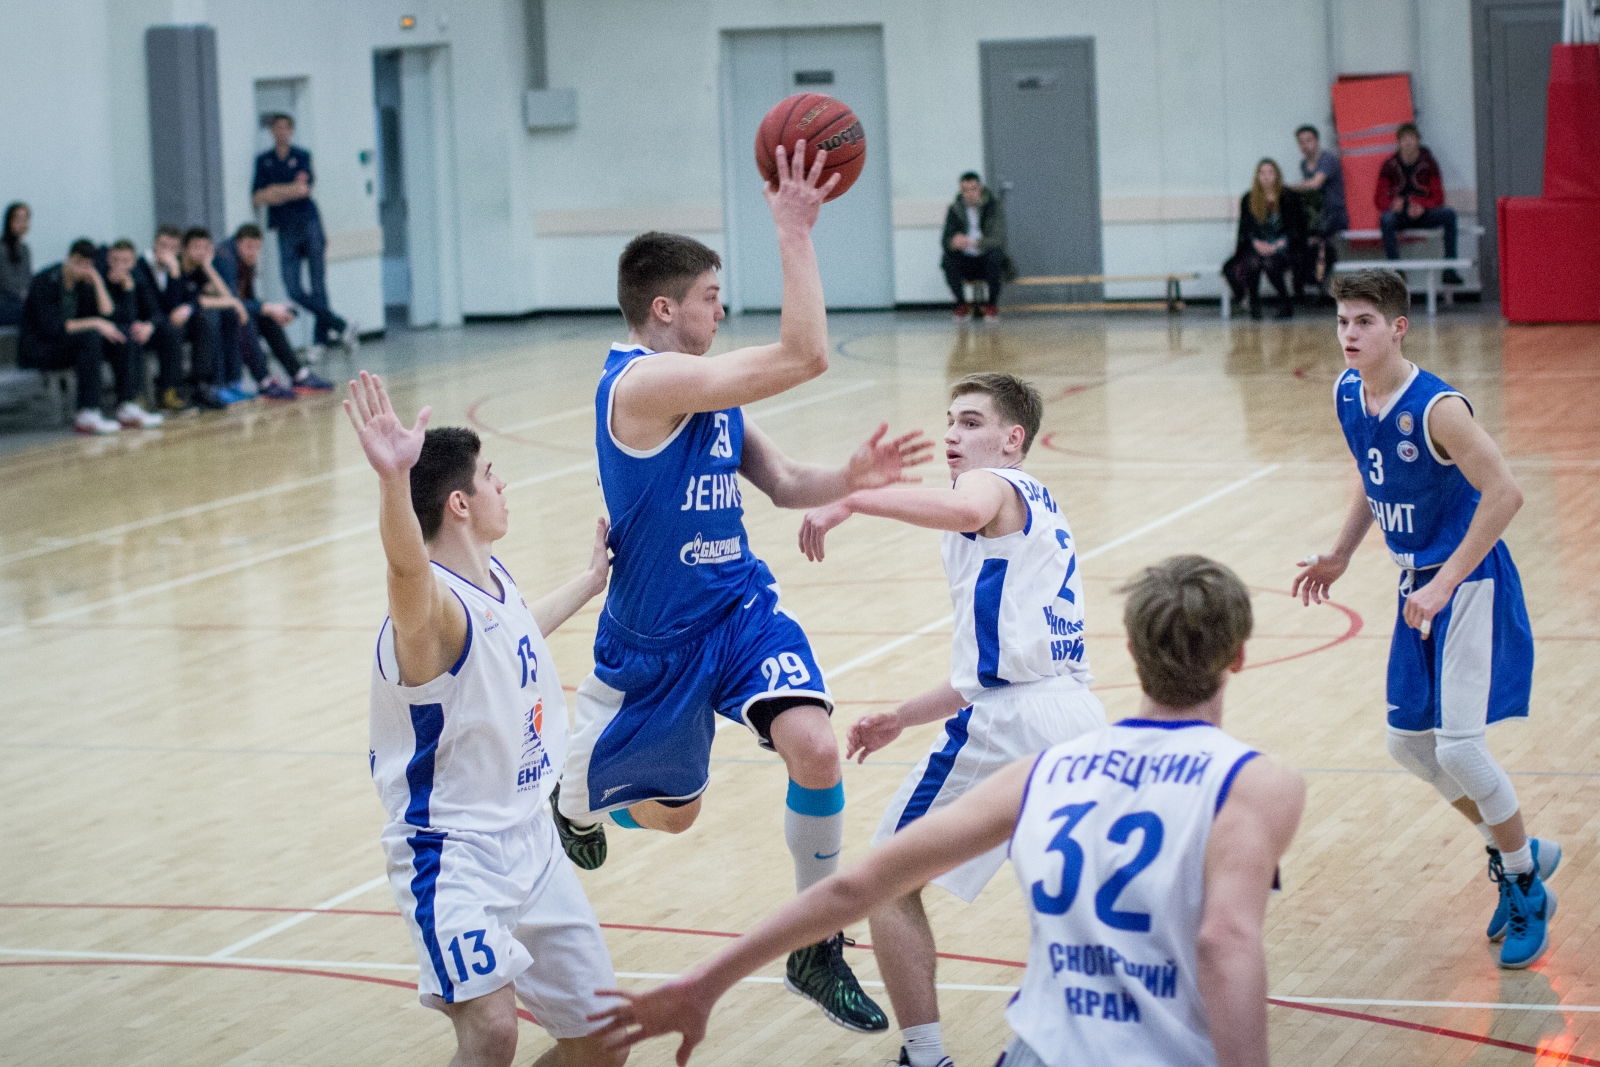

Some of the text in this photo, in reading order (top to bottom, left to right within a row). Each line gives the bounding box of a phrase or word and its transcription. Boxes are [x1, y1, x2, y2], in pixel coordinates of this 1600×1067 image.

[1368, 447, 1384, 485] 3
[761, 652, 811, 692] 29
[1032, 801, 1165, 933] 32
[448, 929, 497, 982] 13
